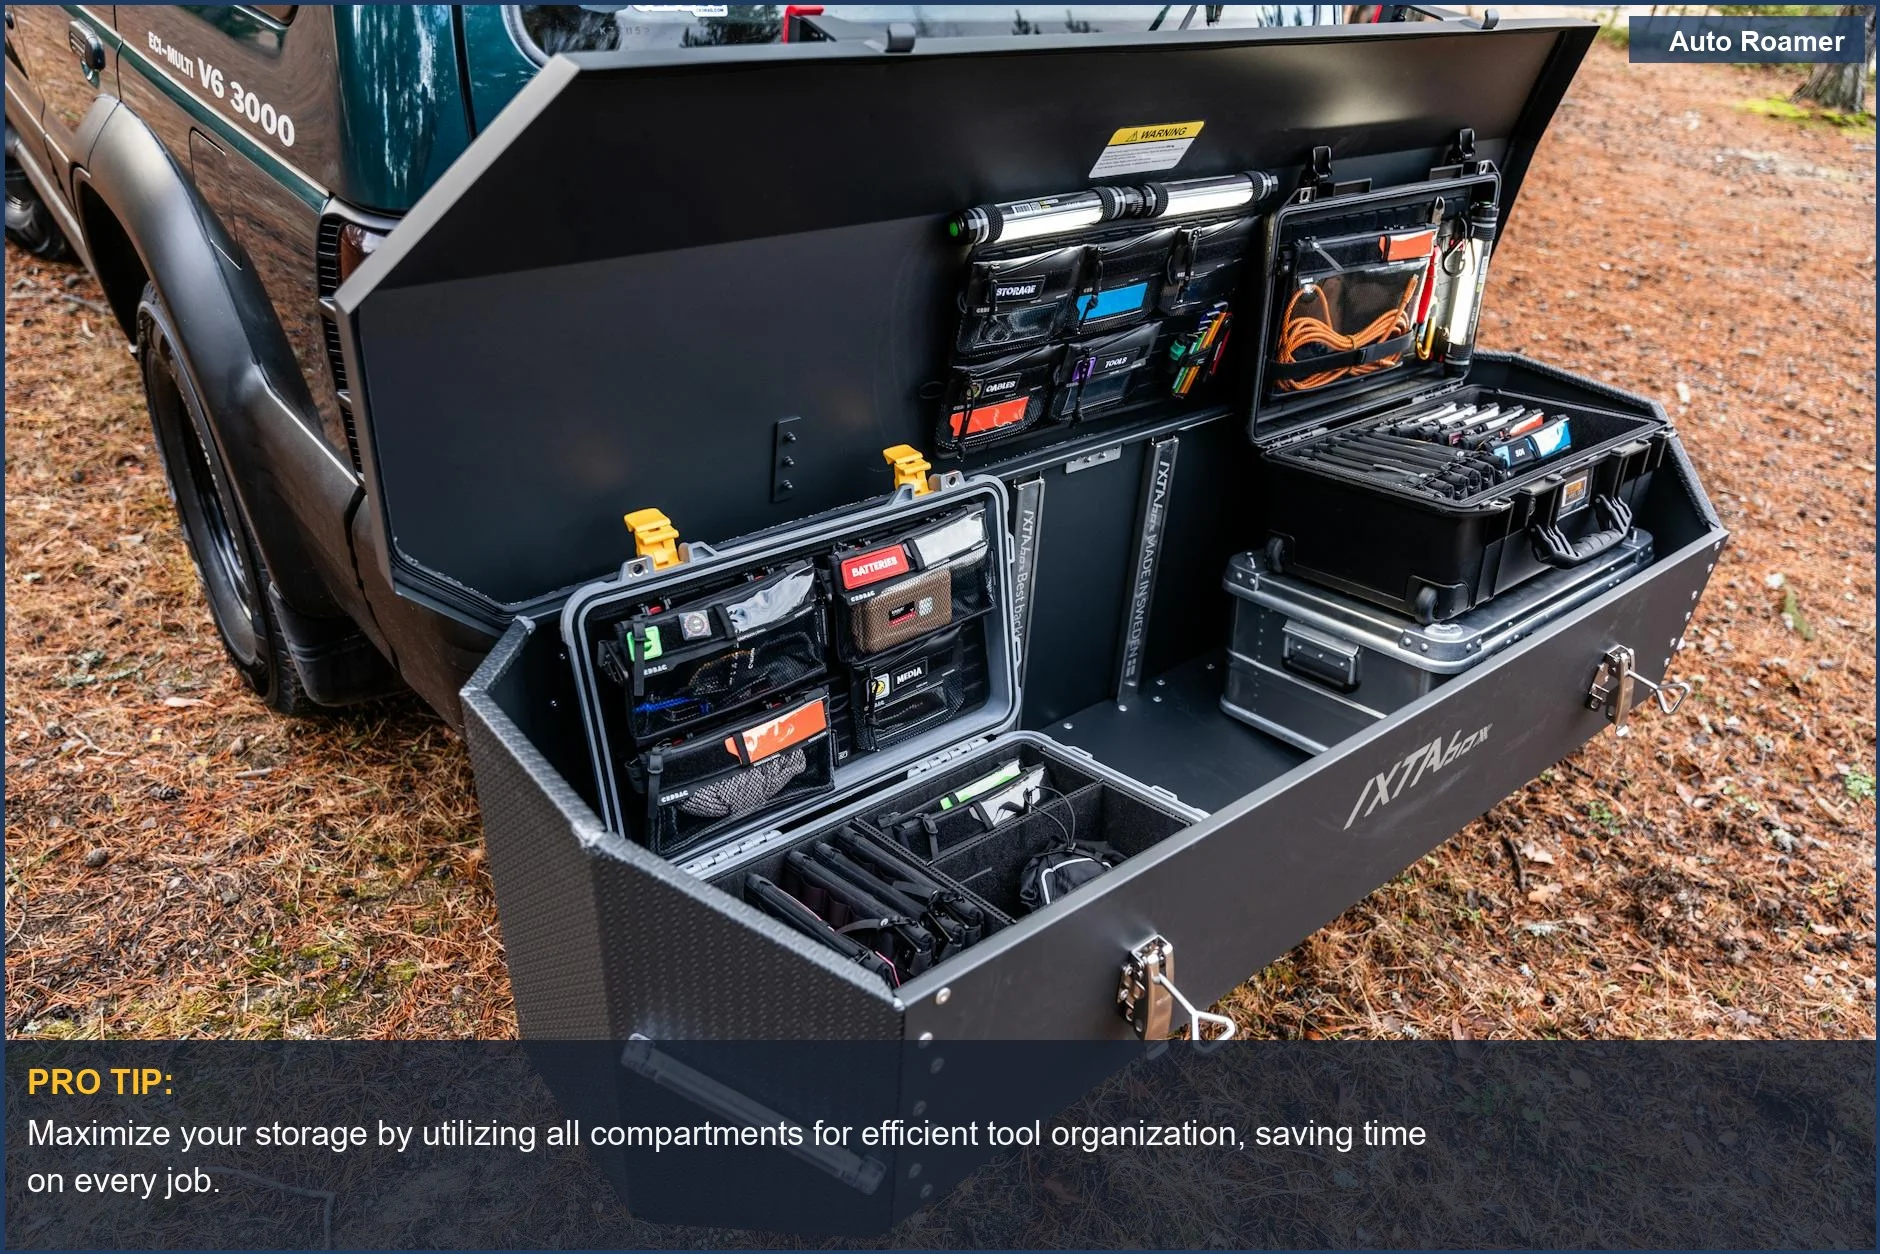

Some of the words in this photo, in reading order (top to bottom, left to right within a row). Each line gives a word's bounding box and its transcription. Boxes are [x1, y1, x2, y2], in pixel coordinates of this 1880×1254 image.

[148, 31, 194, 78] ECI-MULTI
[197, 57, 225, 99] V6
[230, 80, 295, 147] 3000
[1140, 127, 1188, 140] WARNING
[995, 285, 1037, 297] STORAGE
[1104, 356, 1128, 369] TOOLS
[985, 380, 1016, 393] CABLES
[1141, 534, 1158, 577] MADE
[851, 555, 898, 578] BATTERIES
[1014, 571, 1028, 604] Best
[1138, 581, 1149, 599] IN
[1128, 600, 1147, 659] SWEDEN
[896, 666, 923, 685] MEDIA
